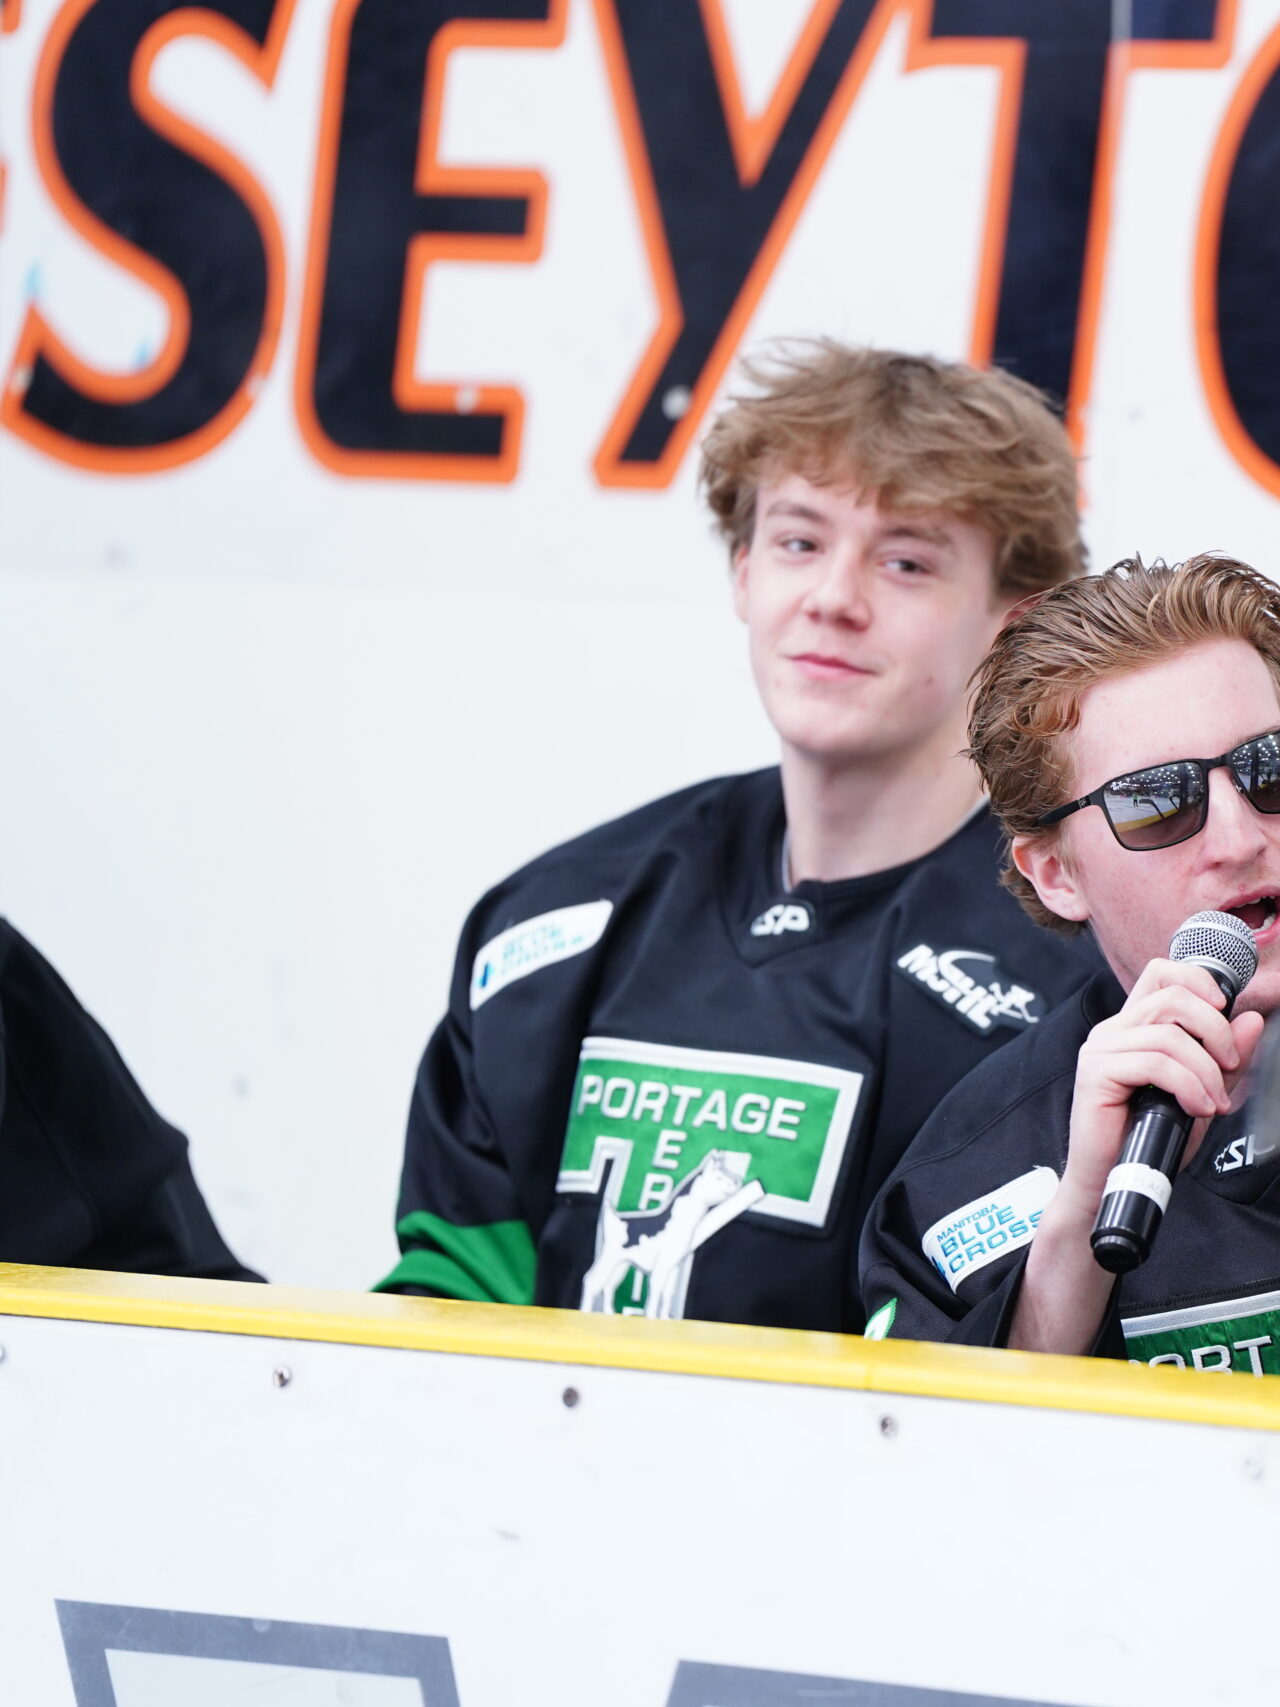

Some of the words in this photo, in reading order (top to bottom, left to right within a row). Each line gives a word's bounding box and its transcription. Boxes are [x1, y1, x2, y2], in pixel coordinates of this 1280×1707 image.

[576, 1074, 806, 1141] PORTAGE
[936, 1203, 999, 1241] MANITOBA
[940, 1205, 1016, 1258] BLUE
